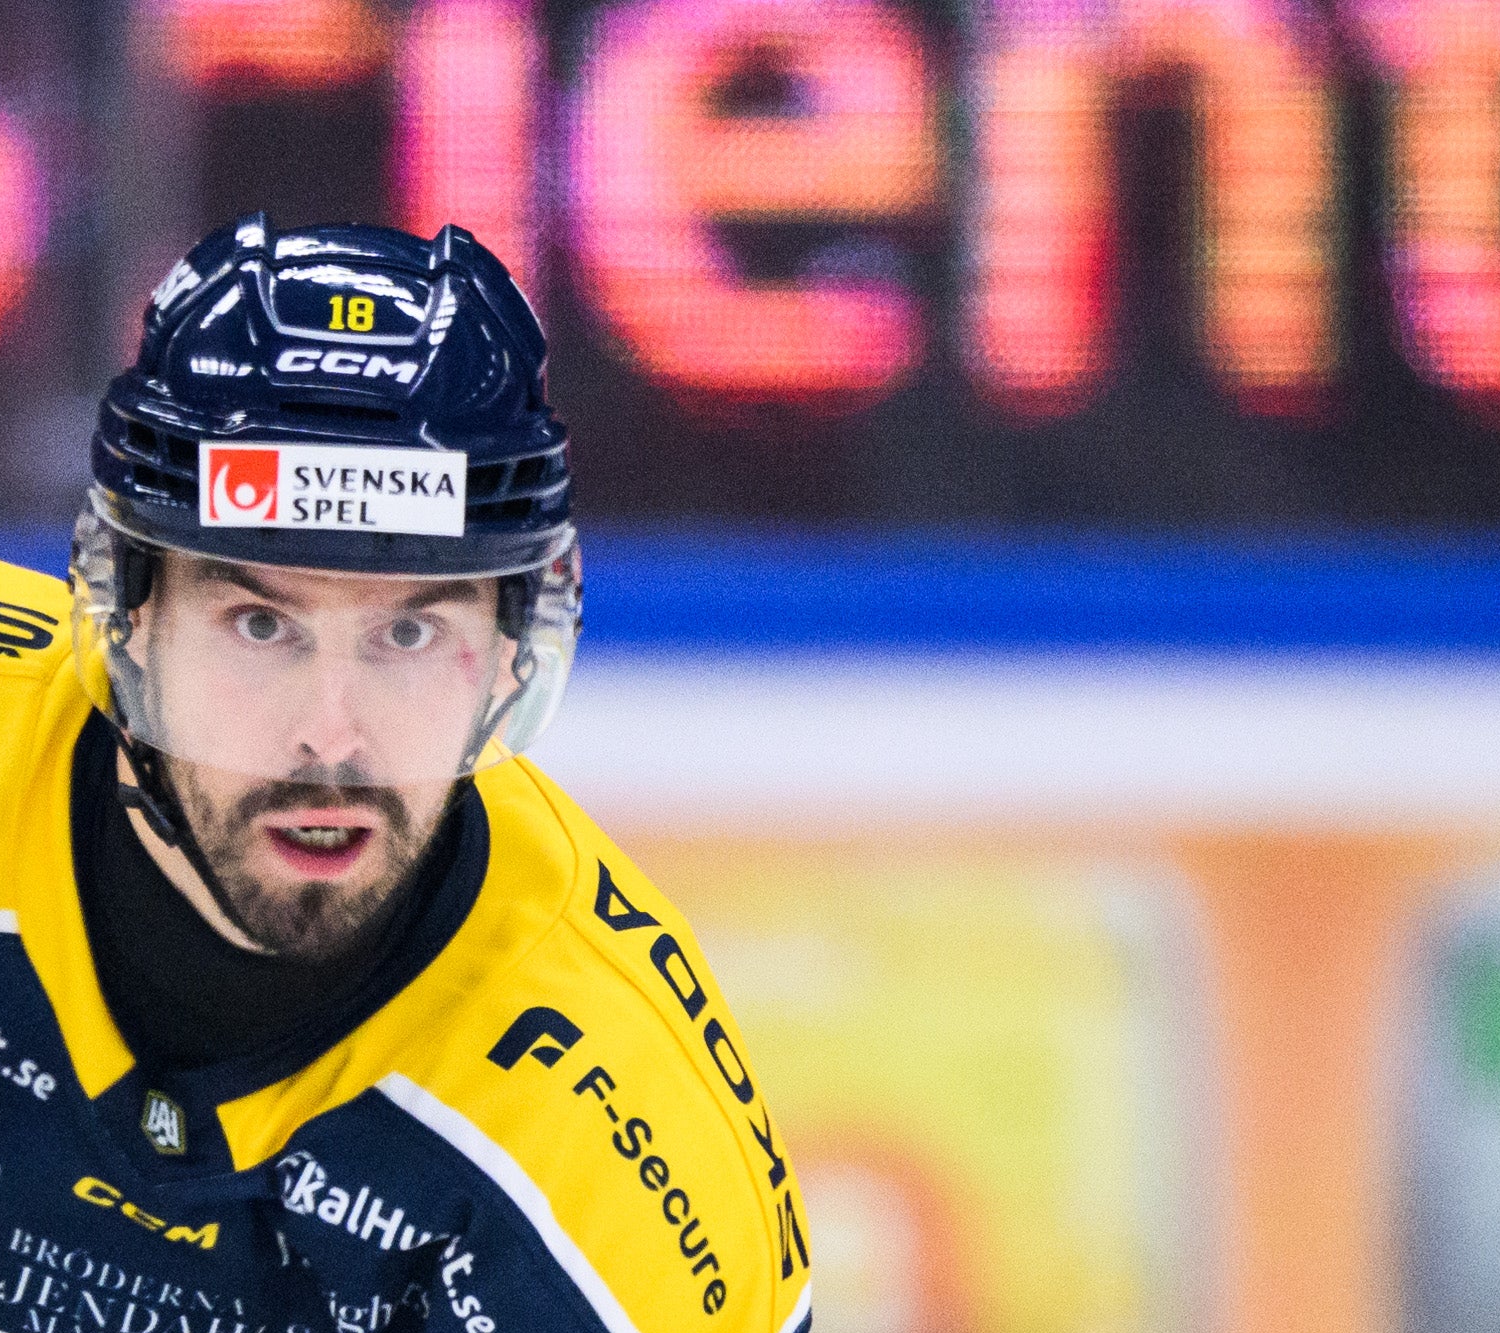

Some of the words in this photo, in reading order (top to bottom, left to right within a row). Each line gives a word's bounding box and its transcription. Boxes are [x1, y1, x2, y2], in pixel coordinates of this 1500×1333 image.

[327, 294, 376, 333] 18
[275, 349, 419, 384] CCM
[293, 464, 456, 499] SVENSKA
[292, 497, 377, 526] SPEL
[572, 1065, 728, 1317] F-Secure
